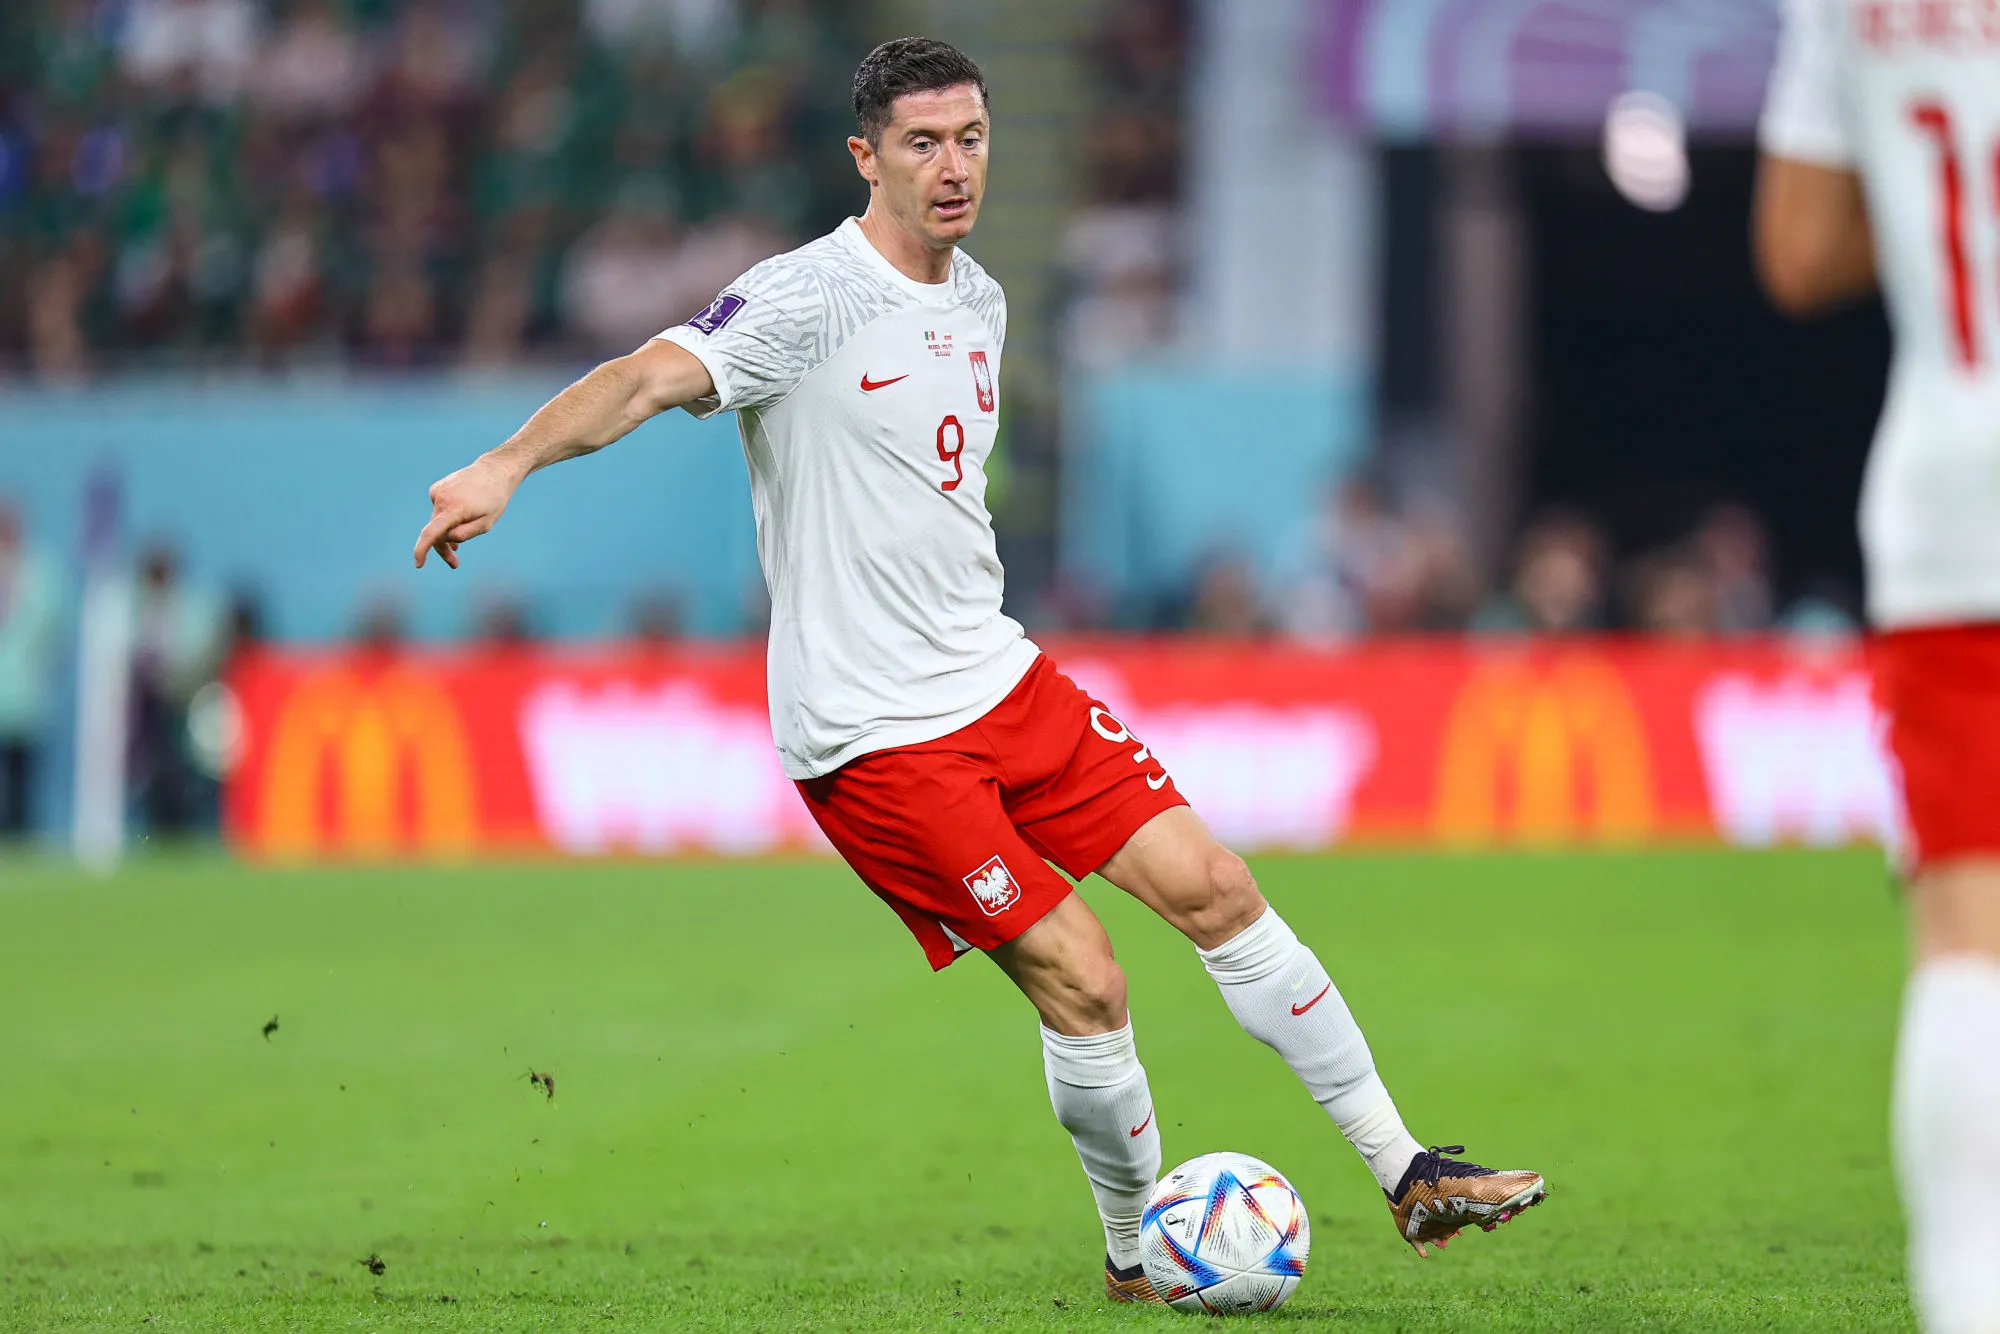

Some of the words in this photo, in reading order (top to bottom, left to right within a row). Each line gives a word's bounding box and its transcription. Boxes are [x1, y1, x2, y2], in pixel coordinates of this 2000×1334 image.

[1905, 98, 2000, 375] 1
[937, 415, 964, 491] 9
[1089, 706, 1150, 764] 9
